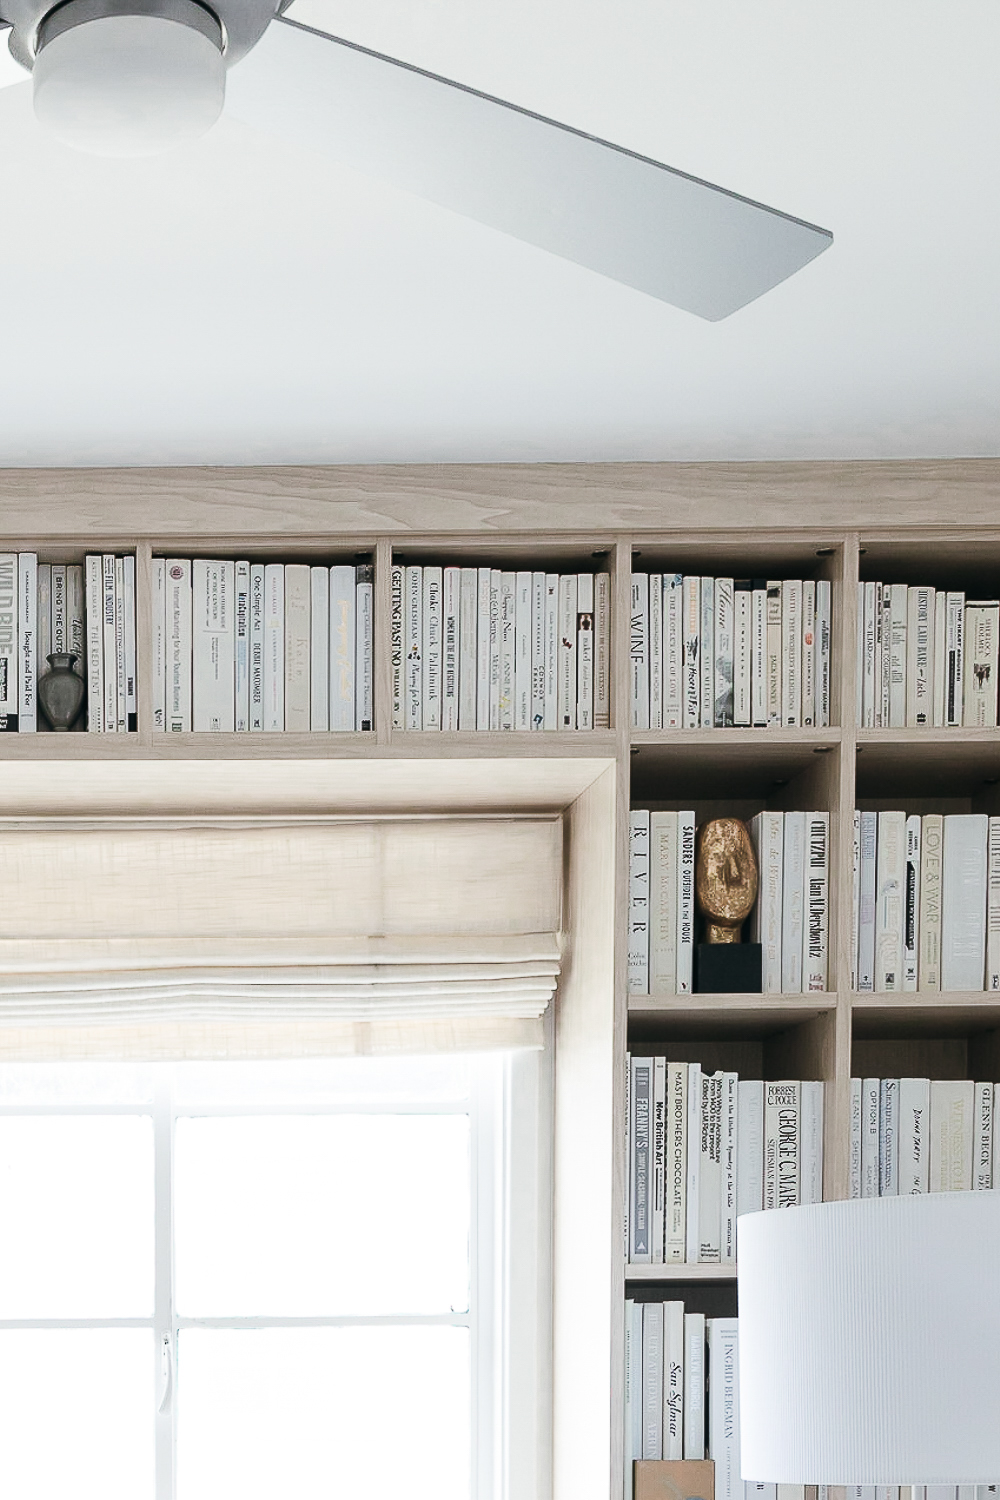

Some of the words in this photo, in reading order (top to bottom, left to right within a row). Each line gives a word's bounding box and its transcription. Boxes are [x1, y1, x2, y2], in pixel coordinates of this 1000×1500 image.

[391, 572, 402, 620] GETTING
[391, 622, 402, 649] PAST
[392, 651, 402, 666] NO
[682, 826, 693, 865] SANDERS
[926, 826, 940, 868] LOVE
[926, 872, 940, 885] &
[926, 888, 940, 923] WAR
[682, 923, 691, 944] HOUSE
[674, 1072, 683, 1097] MAST
[674, 1100, 683, 1147] BROTHERS
[981, 1089, 990, 1132] GLENN
[778, 1110, 797, 1157] GEORGE
[980, 1136, 989, 1166] BECK
[669, 1362, 682, 1387] San
[724, 1344, 734, 1383] INGRID
[724, 1387, 734, 1439] BERGMAN
